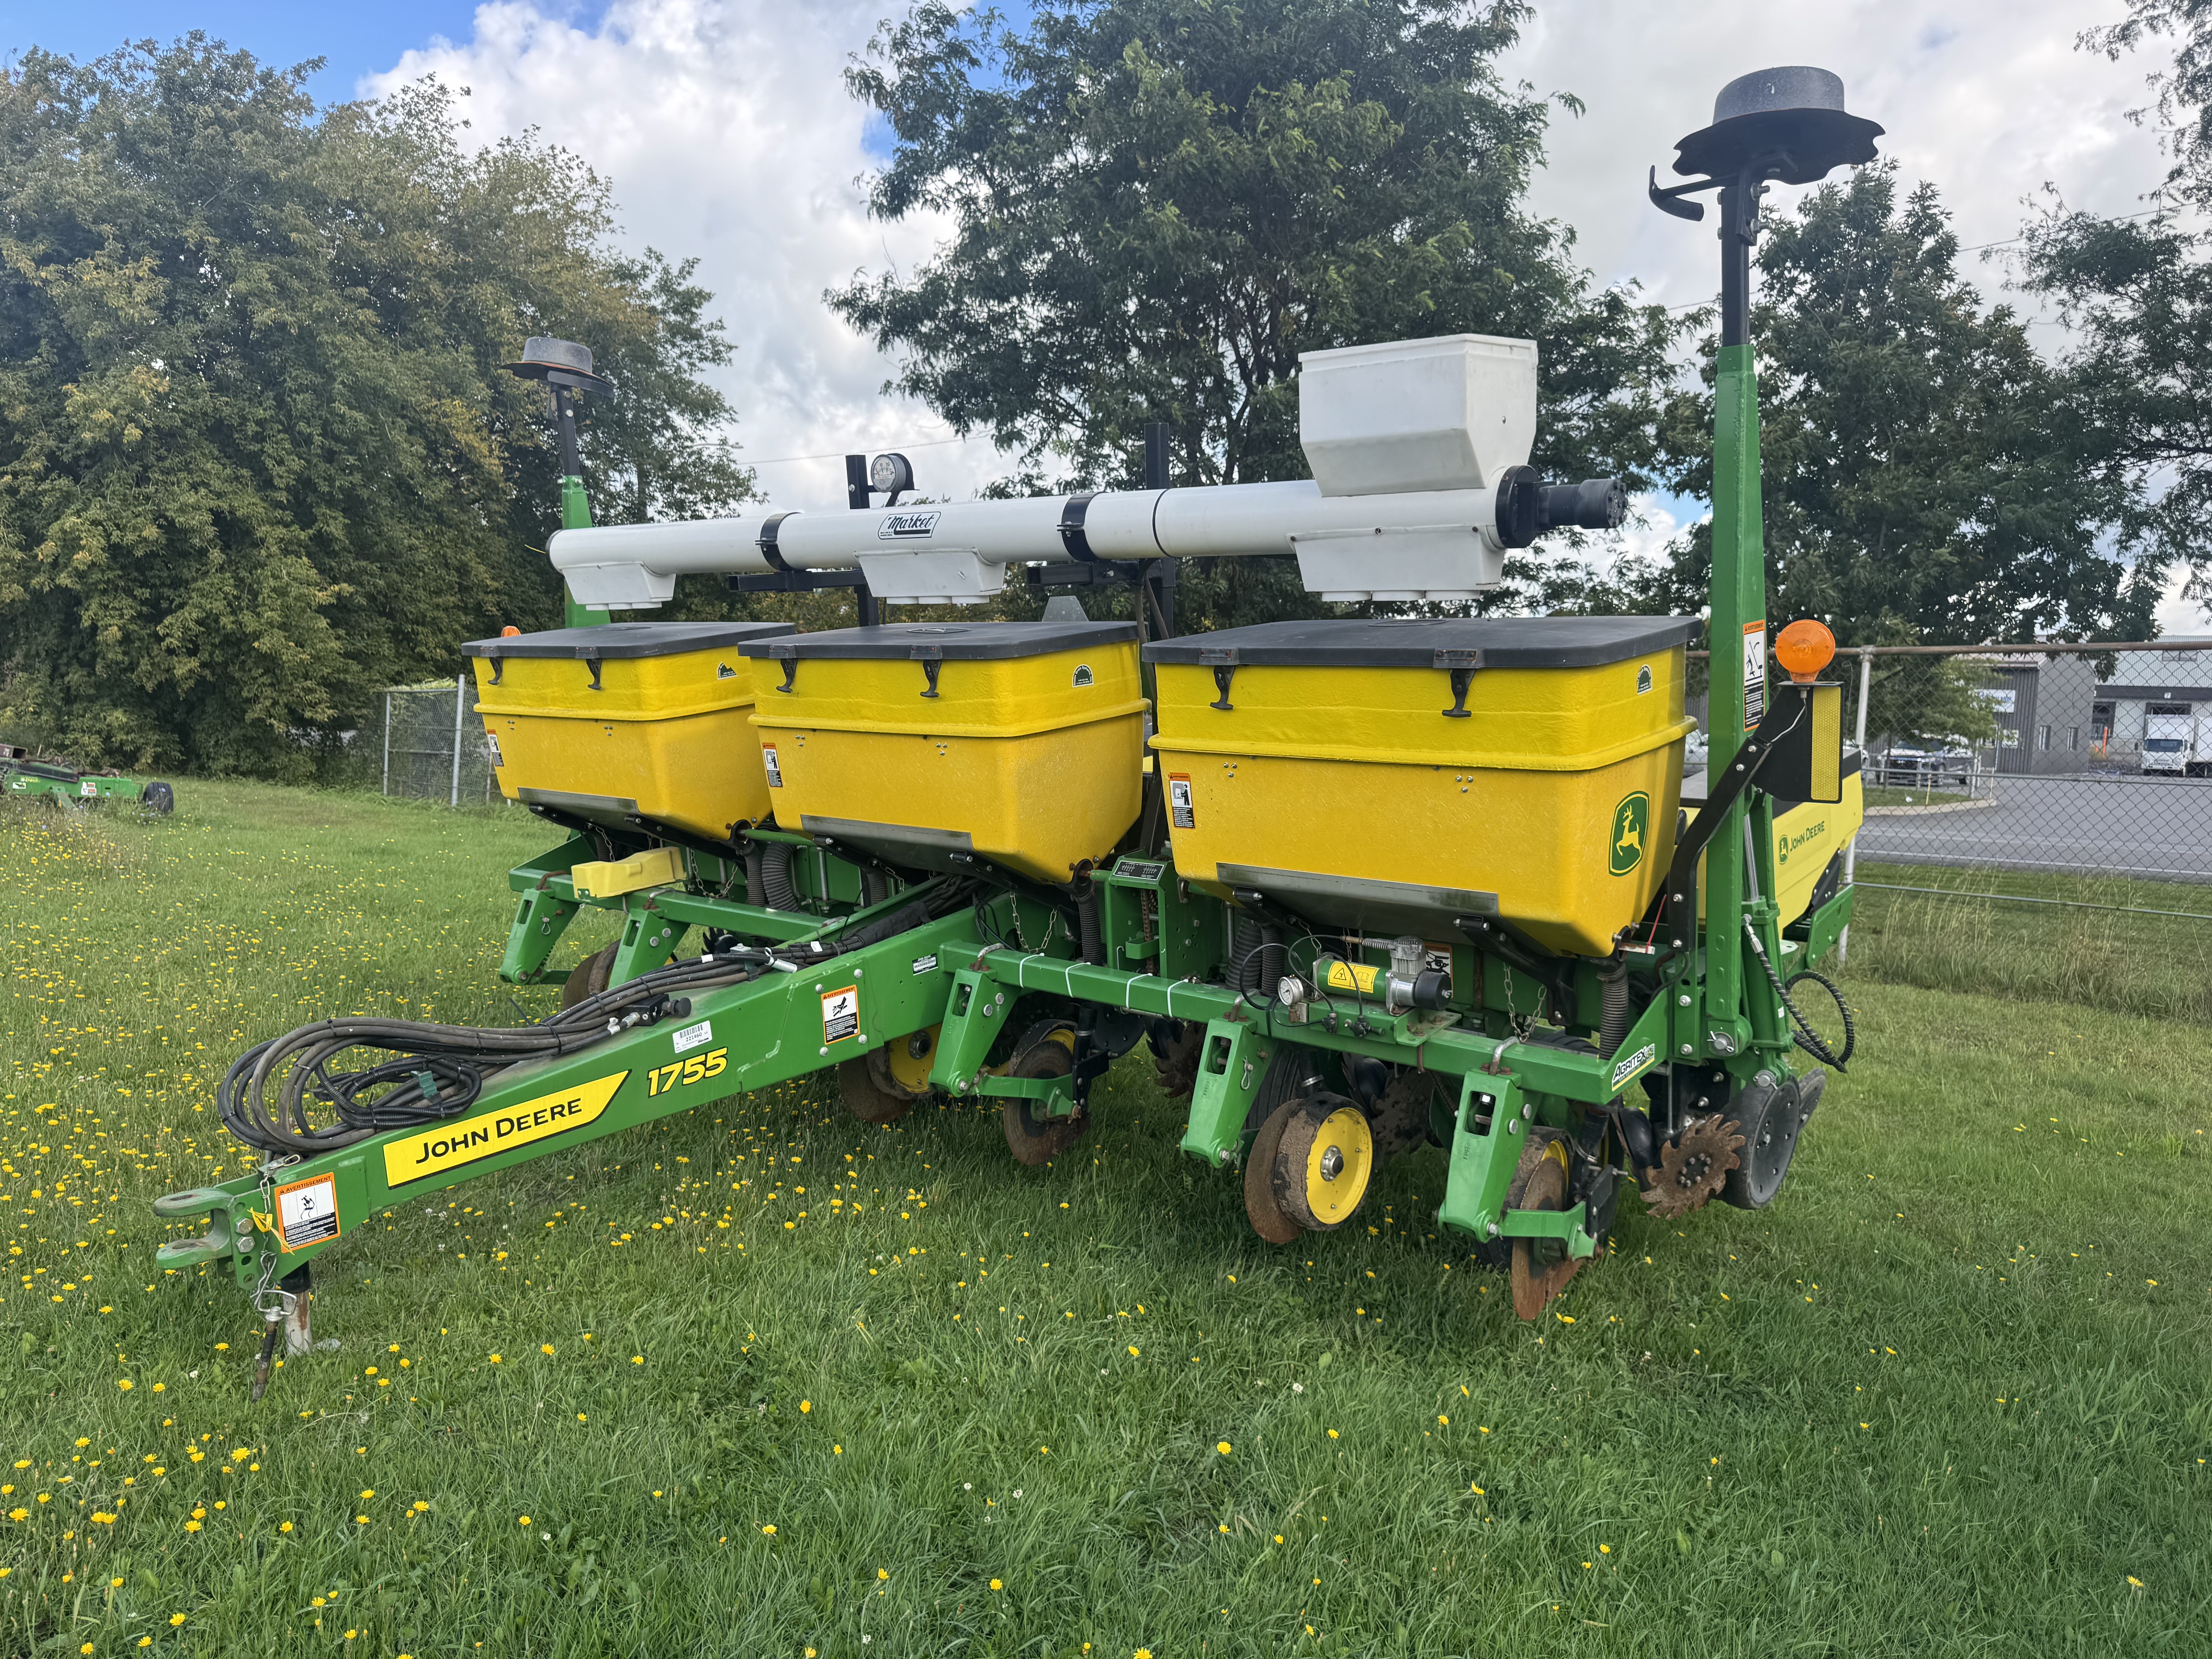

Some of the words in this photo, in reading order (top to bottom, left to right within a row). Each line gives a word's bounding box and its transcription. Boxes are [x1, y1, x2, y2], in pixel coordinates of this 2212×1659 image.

[888, 514, 934, 529] Market
[1790, 833, 1805, 852] JOHN
[1806, 821, 1825, 842] DEERE
[827, 987, 855, 998] AVERTISSEMENT
[686, 1032, 702, 1042] 221460
[647, 1047, 728, 1097] 1755
[1613, 1049, 1646, 1082] AGRITEX
[416, 1127, 489, 1164] JOHN
[496, 1098, 582, 1138] DEERE
[286, 1176, 331, 1192] AVERTISSEMENT
